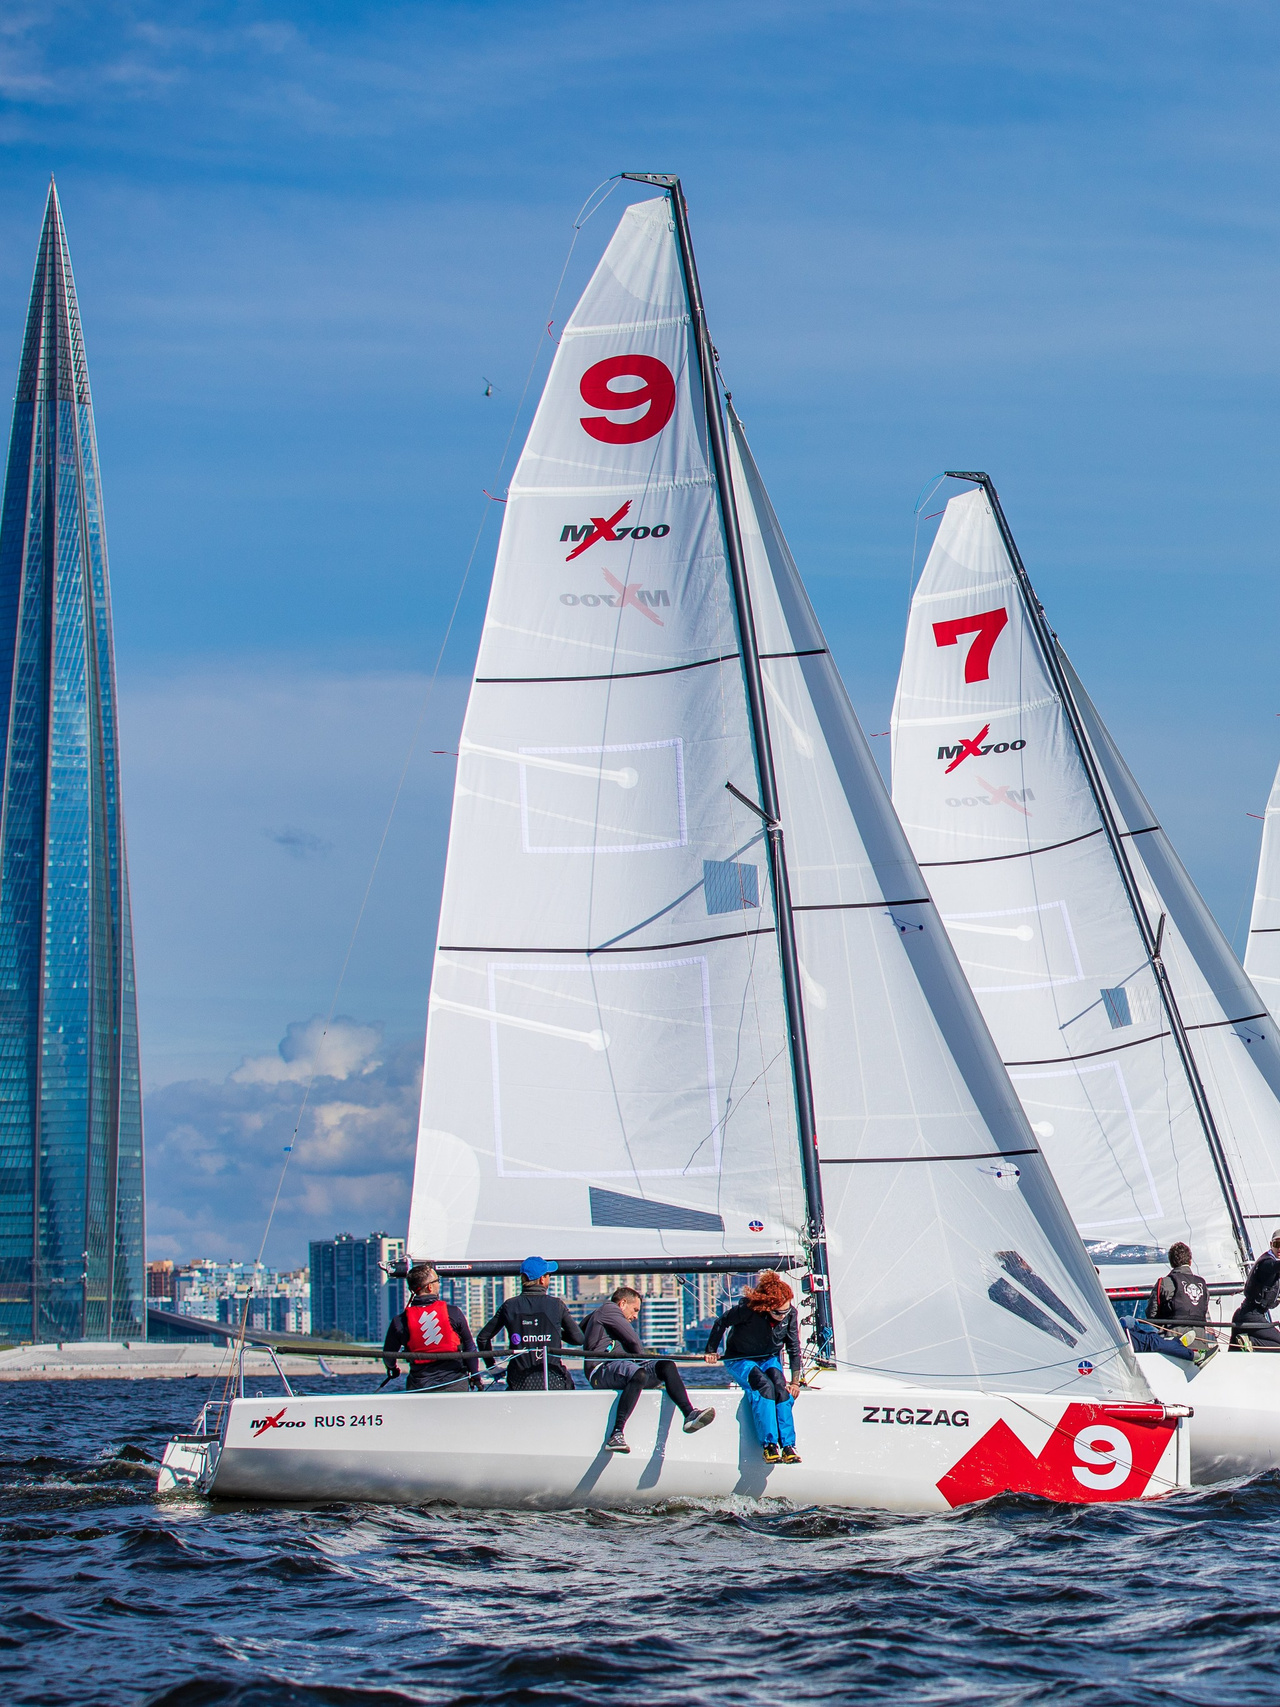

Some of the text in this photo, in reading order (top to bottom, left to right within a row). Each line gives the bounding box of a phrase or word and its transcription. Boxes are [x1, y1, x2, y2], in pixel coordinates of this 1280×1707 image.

[579, 354, 676, 445] 9
[559, 499, 671, 562] MX700
[932, 607, 1009, 684] 7
[937, 723, 1027, 775] MX700
[250, 1407, 383, 1438] MX700 RUS 2415
[862, 1406, 969, 1427] ZIGZAG
[1071, 1424, 1133, 1491] 9
